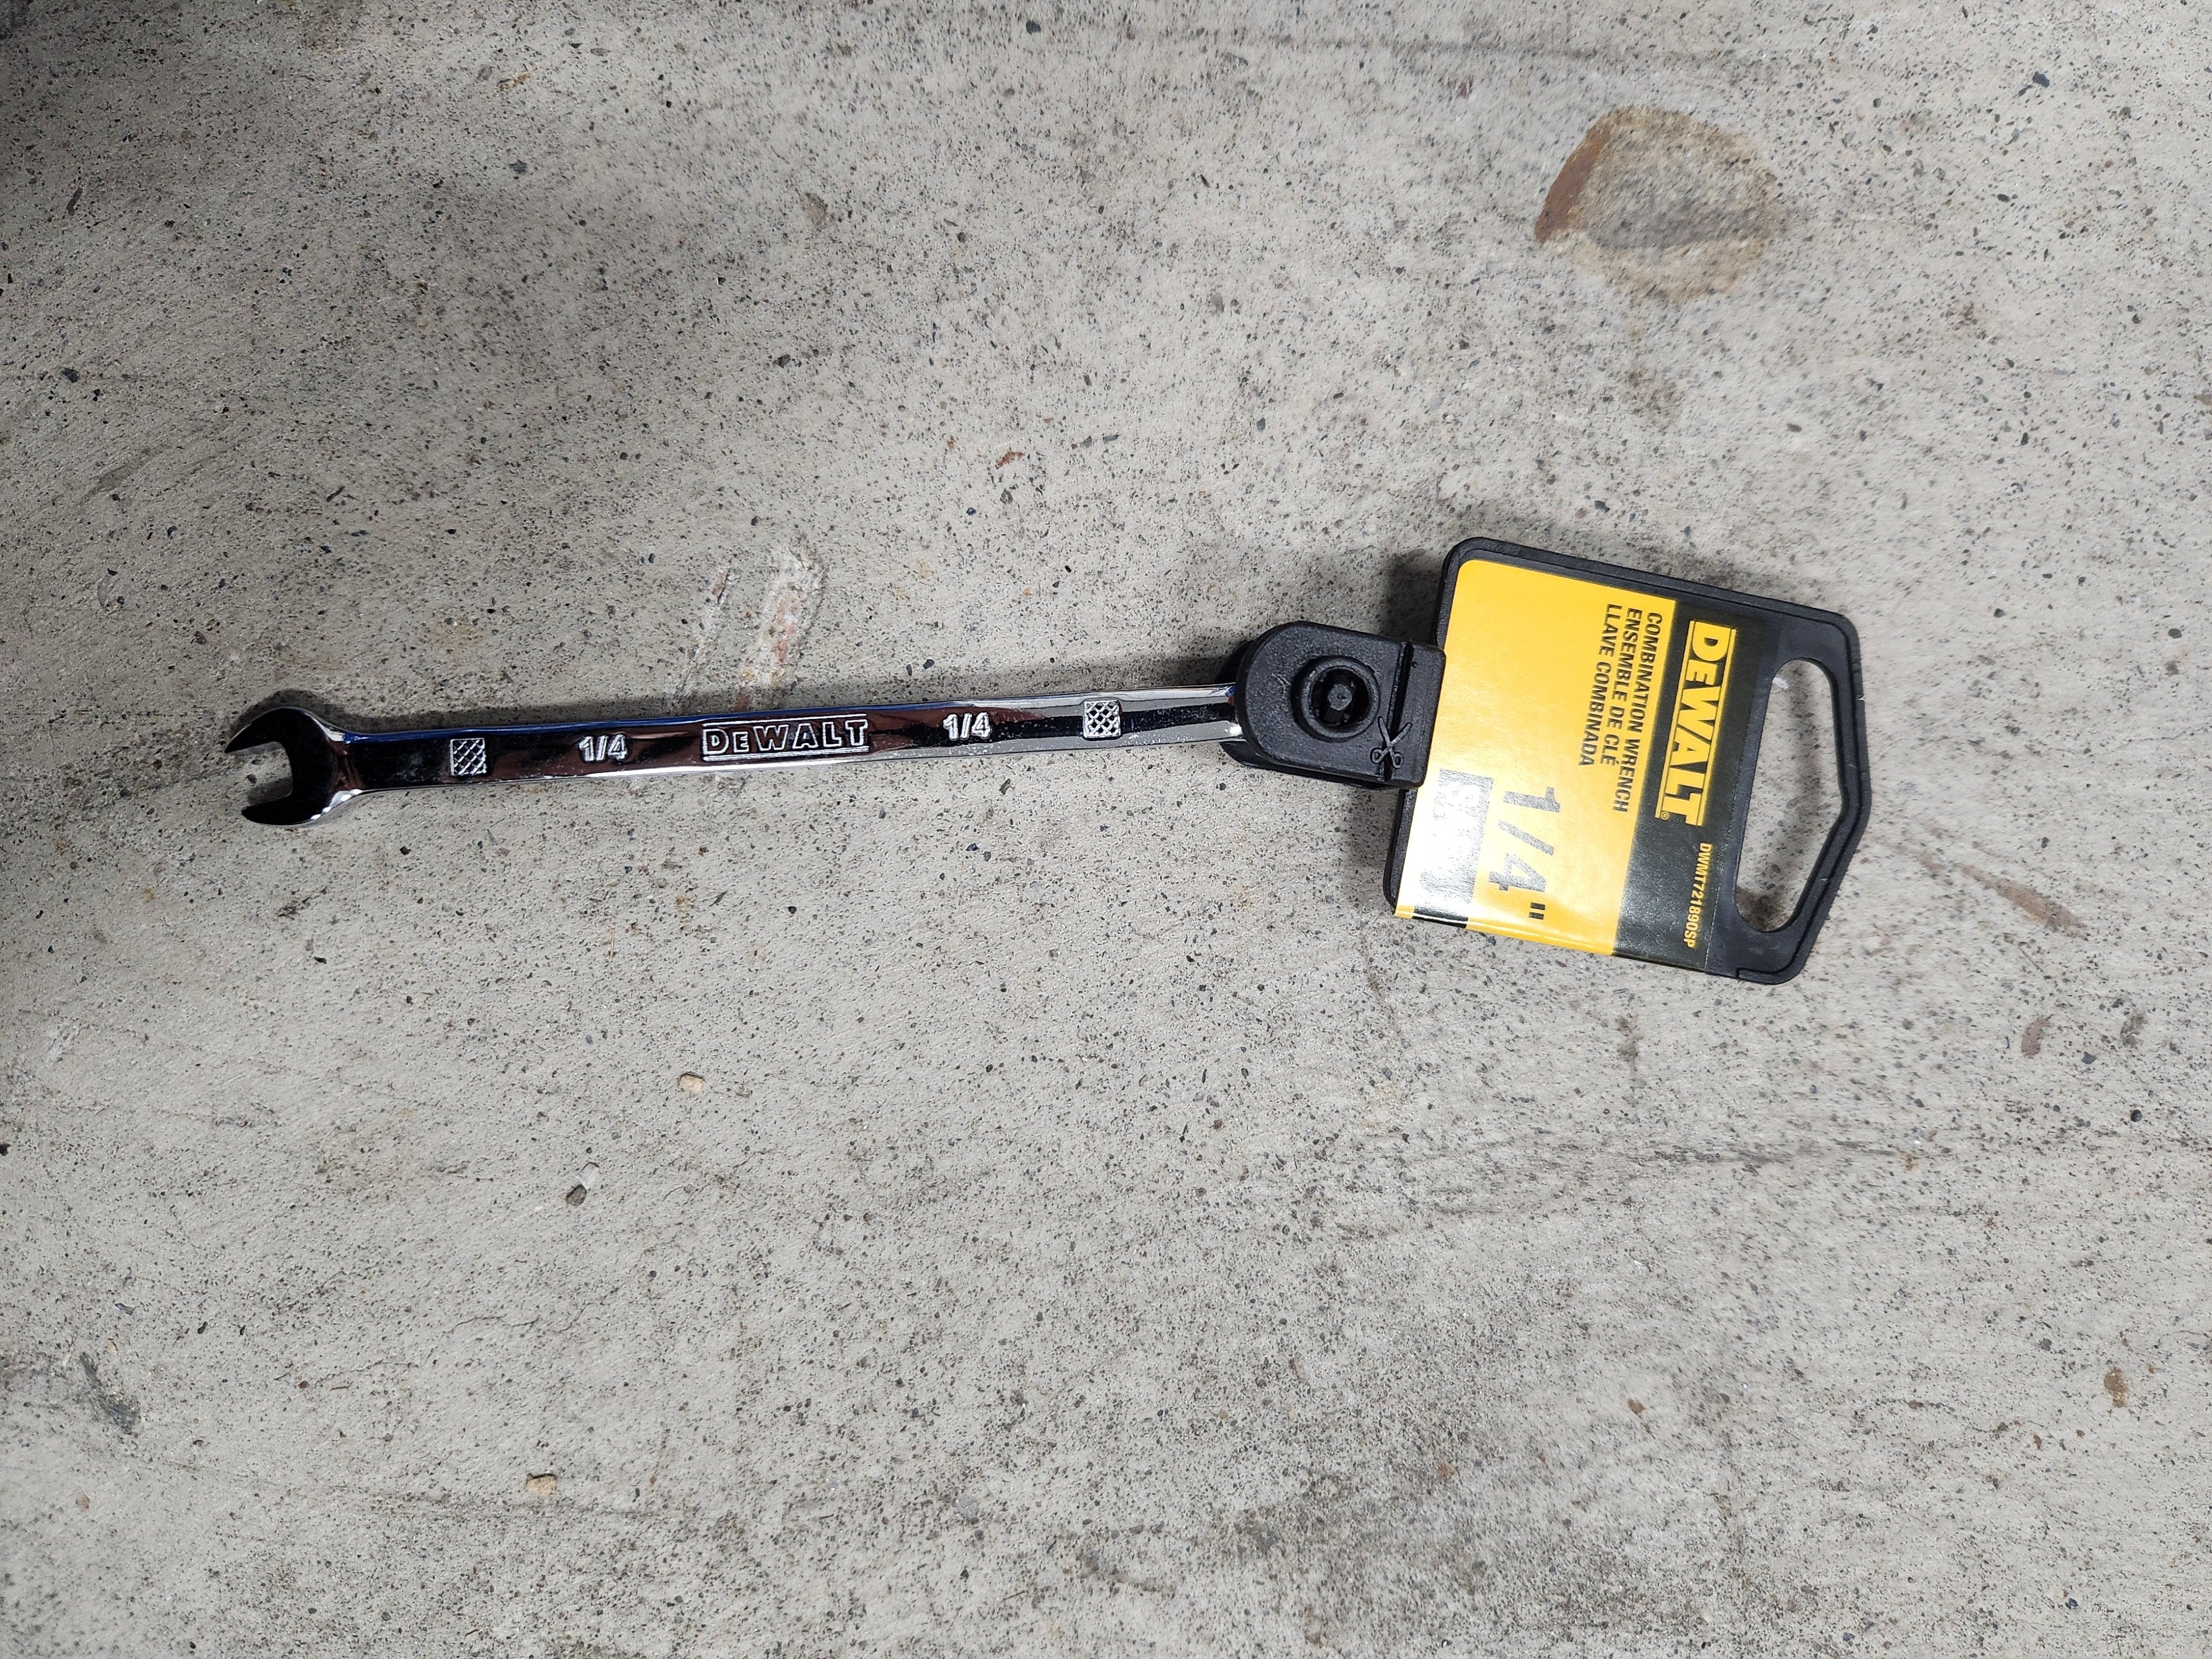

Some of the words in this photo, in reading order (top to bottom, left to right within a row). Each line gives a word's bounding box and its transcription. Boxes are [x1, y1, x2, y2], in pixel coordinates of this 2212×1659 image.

[1598, 604, 1623, 657] LLAVE
[1611, 608, 1642, 702] ENSEMBLE
[1627, 612, 1662, 733] COMBINATION
[578, 733, 629, 763] 1/4
[943, 712, 993, 741] 1/4
[1578, 661, 1611, 765] COMBINADA
[1606, 706, 1625, 729] DE
[1600, 734, 1620, 766] CLÉ
[1613, 739, 1641, 812] WRENCH
[1488, 786, 1561, 920] 1/4"
[1683, 842, 1712, 948] DWMT721890SP
